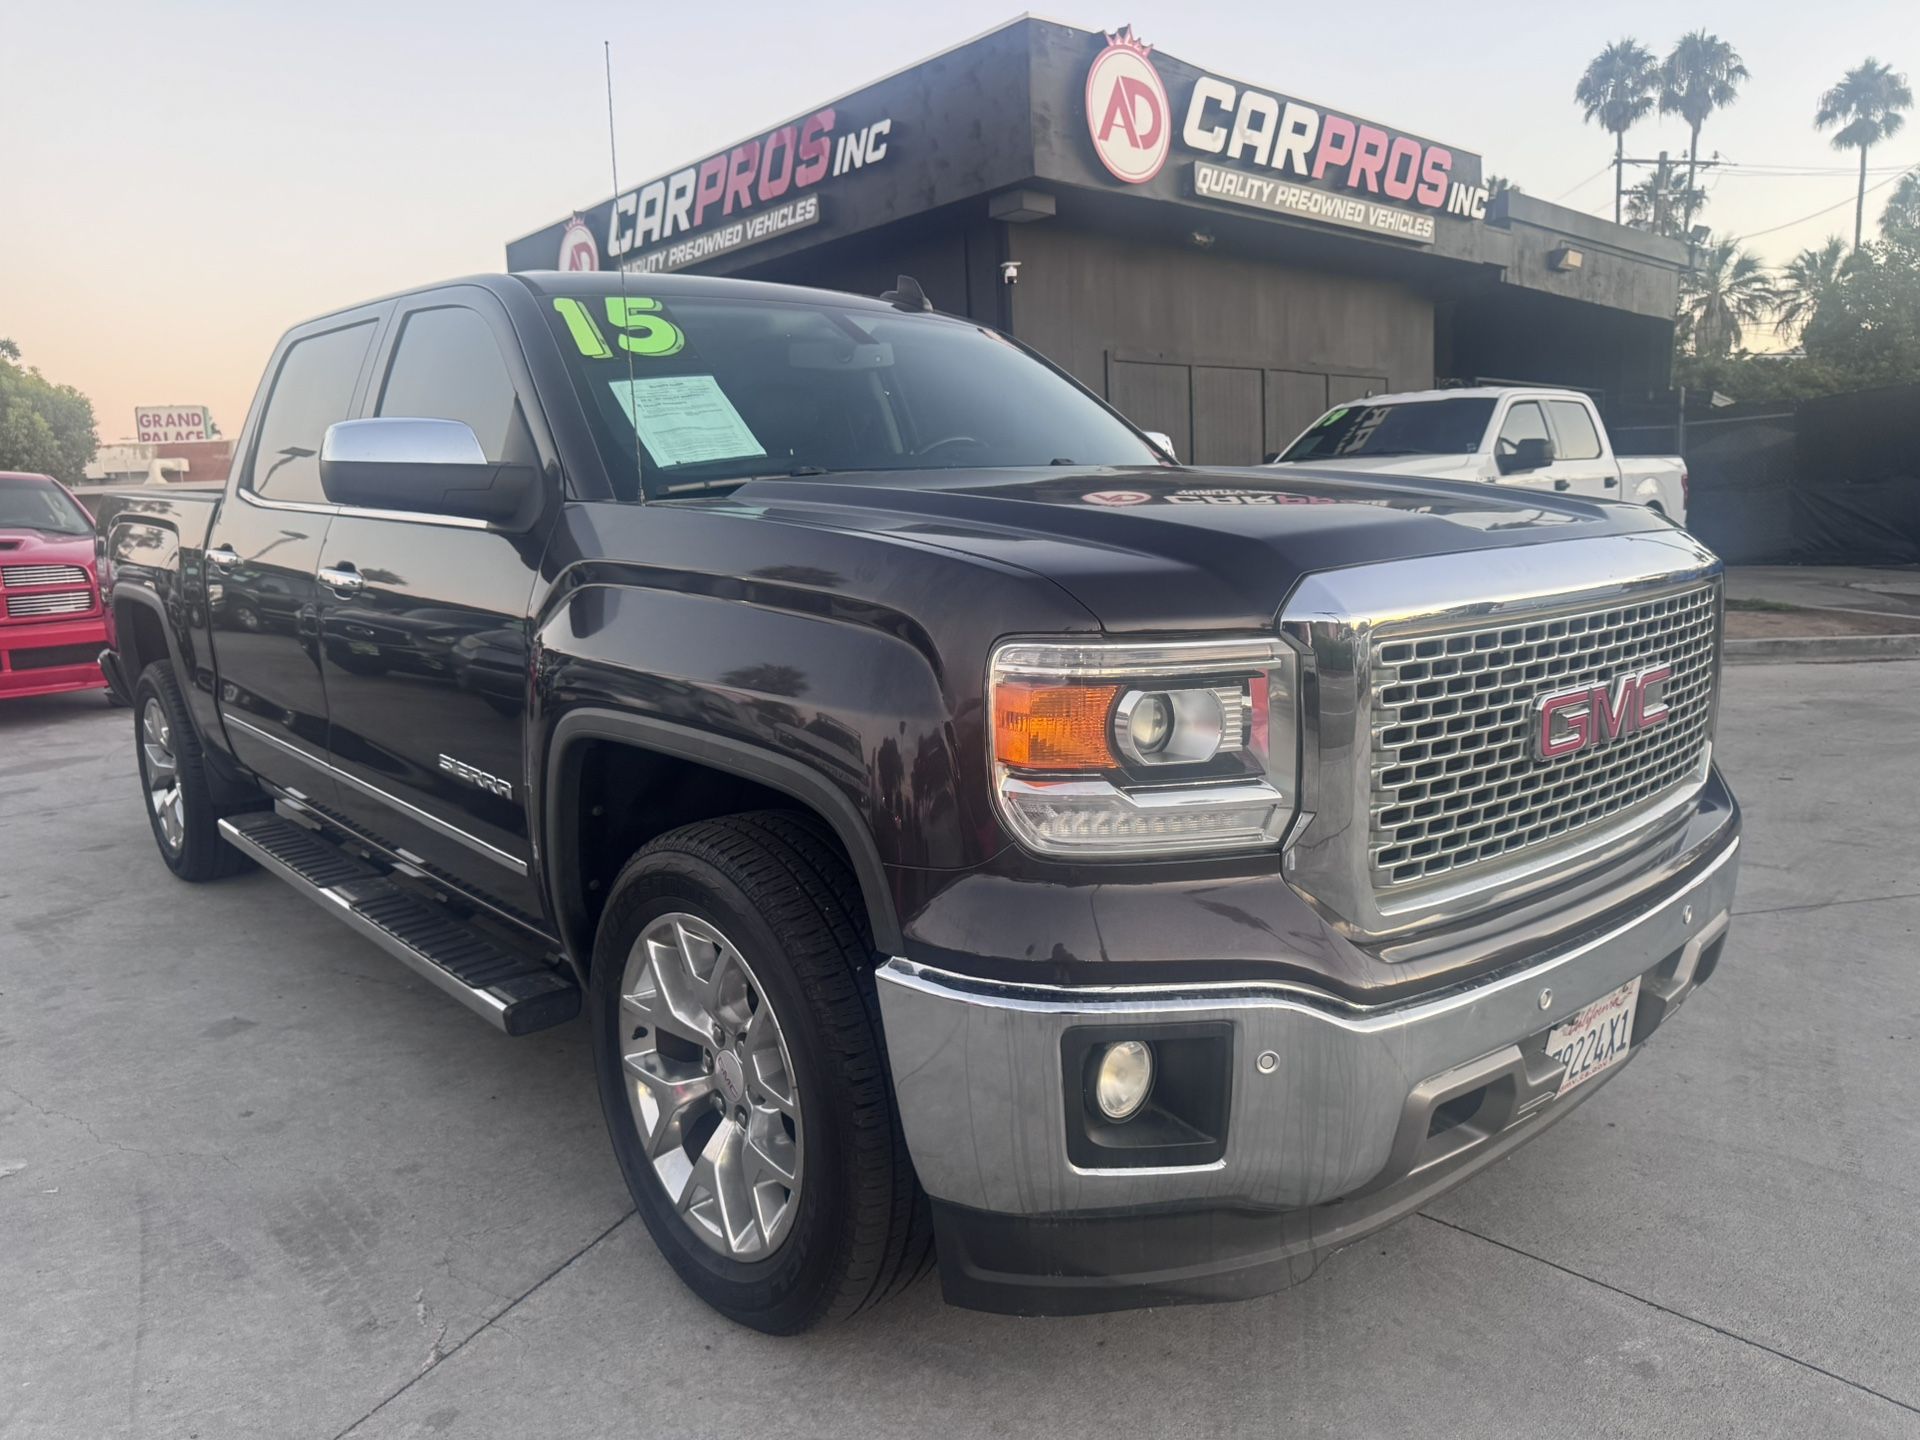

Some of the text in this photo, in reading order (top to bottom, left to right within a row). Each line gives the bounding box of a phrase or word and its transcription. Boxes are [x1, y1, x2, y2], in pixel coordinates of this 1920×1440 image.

[1098, 75, 1162, 150] AD
[833, 118, 891, 177] INC
[746, 197, 817, 240] VEHICLES
[1196, 167, 1274, 203] QUALITY
[1367, 204, 1433, 238] VEHICLES
[1447, 181, 1490, 219] INC
[553, 296, 685, 359] 15
[140, 412, 202, 428] GRAND
[1534, 663, 1672, 760] GMC
[439, 753, 512, 800] SIERRA
